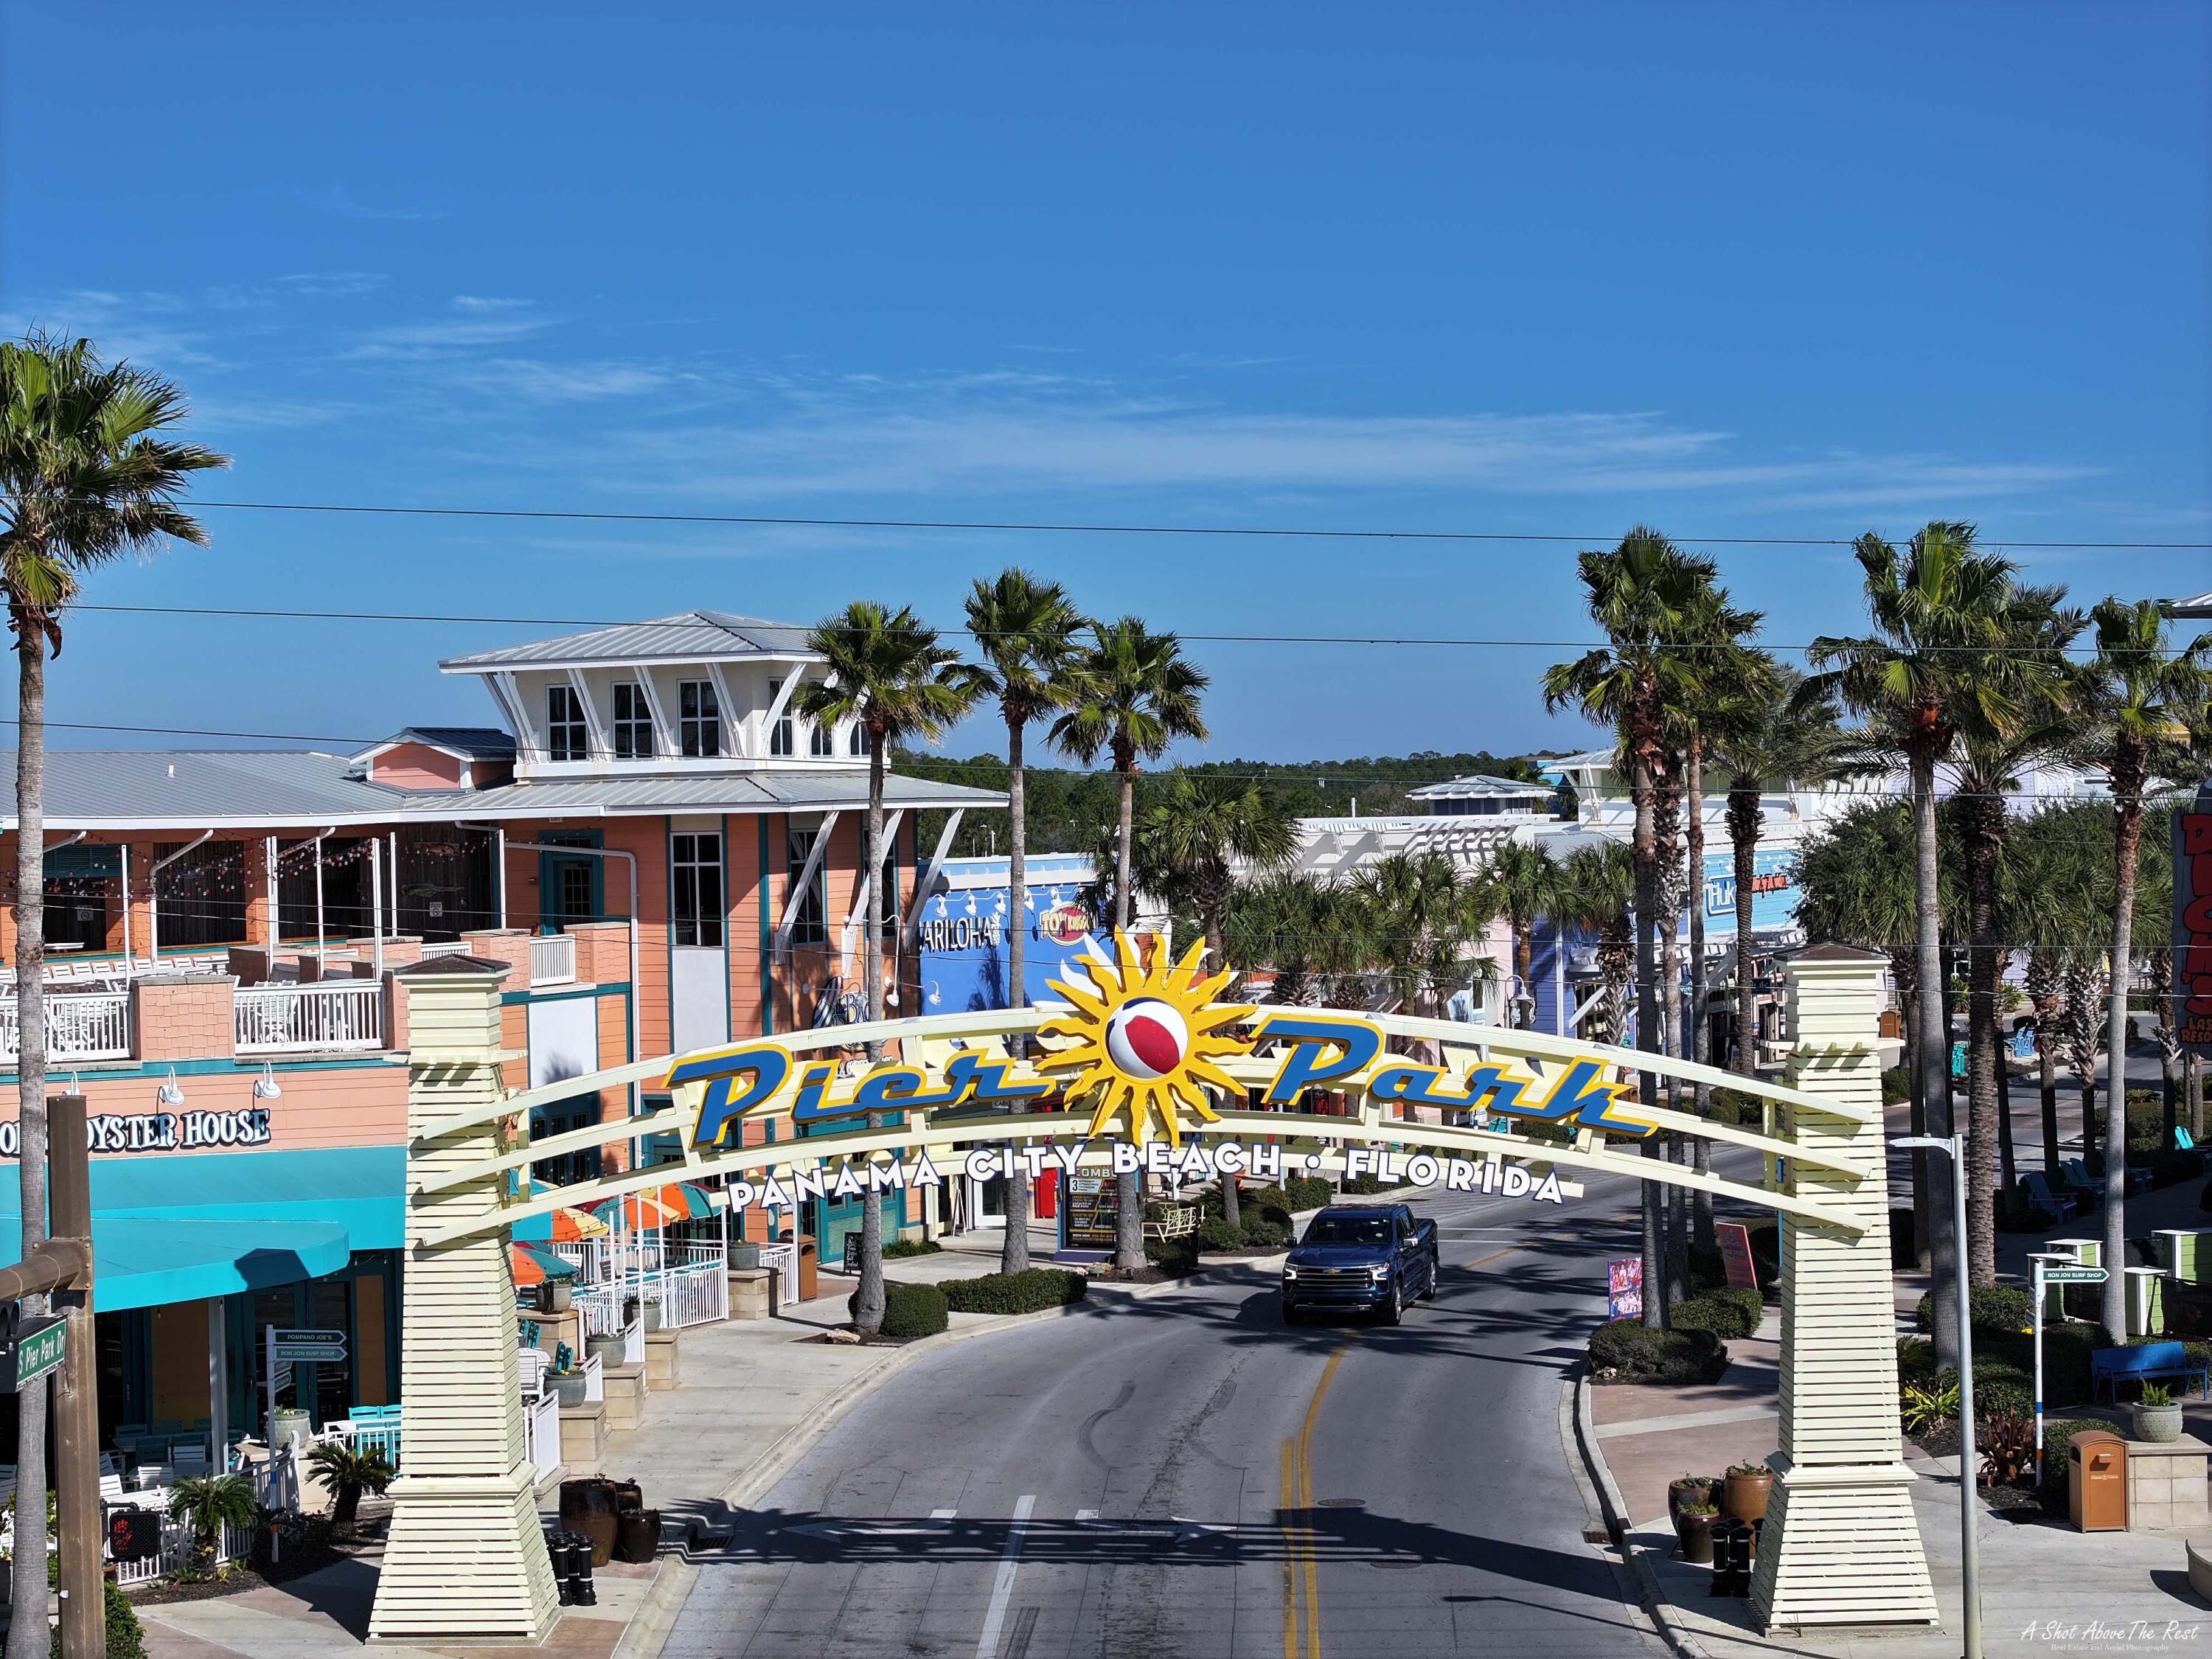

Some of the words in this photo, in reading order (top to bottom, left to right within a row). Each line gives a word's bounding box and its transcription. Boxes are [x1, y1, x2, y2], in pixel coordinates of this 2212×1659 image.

[919, 917, 993, 951] ARILOHA
[2181, 1029, 2212, 1043] RESO
[2187, 1017, 2212, 1031] LAS
[661, 1043, 1056, 1148] Pier
[1249, 1012, 1659, 1137] Park
[181, 1108, 271, 1148] HOUSE
[728, 1152, 945, 1214] PANAMA
[965, 1145, 1088, 1183] CITY
[1113, 1141, 1282, 1176] BEACH
[1346, 1147, 1565, 1206] FLORIDA
[1072, 1180, 1078, 1191] 3
[1075, 1168, 1117, 1178] OMB
[18, 1349, 24, 1375] S
[26, 1346, 39, 1371] Pier
[41, 1335, 55, 1363] Park
[57, 1330, 65, 1354] Dr
